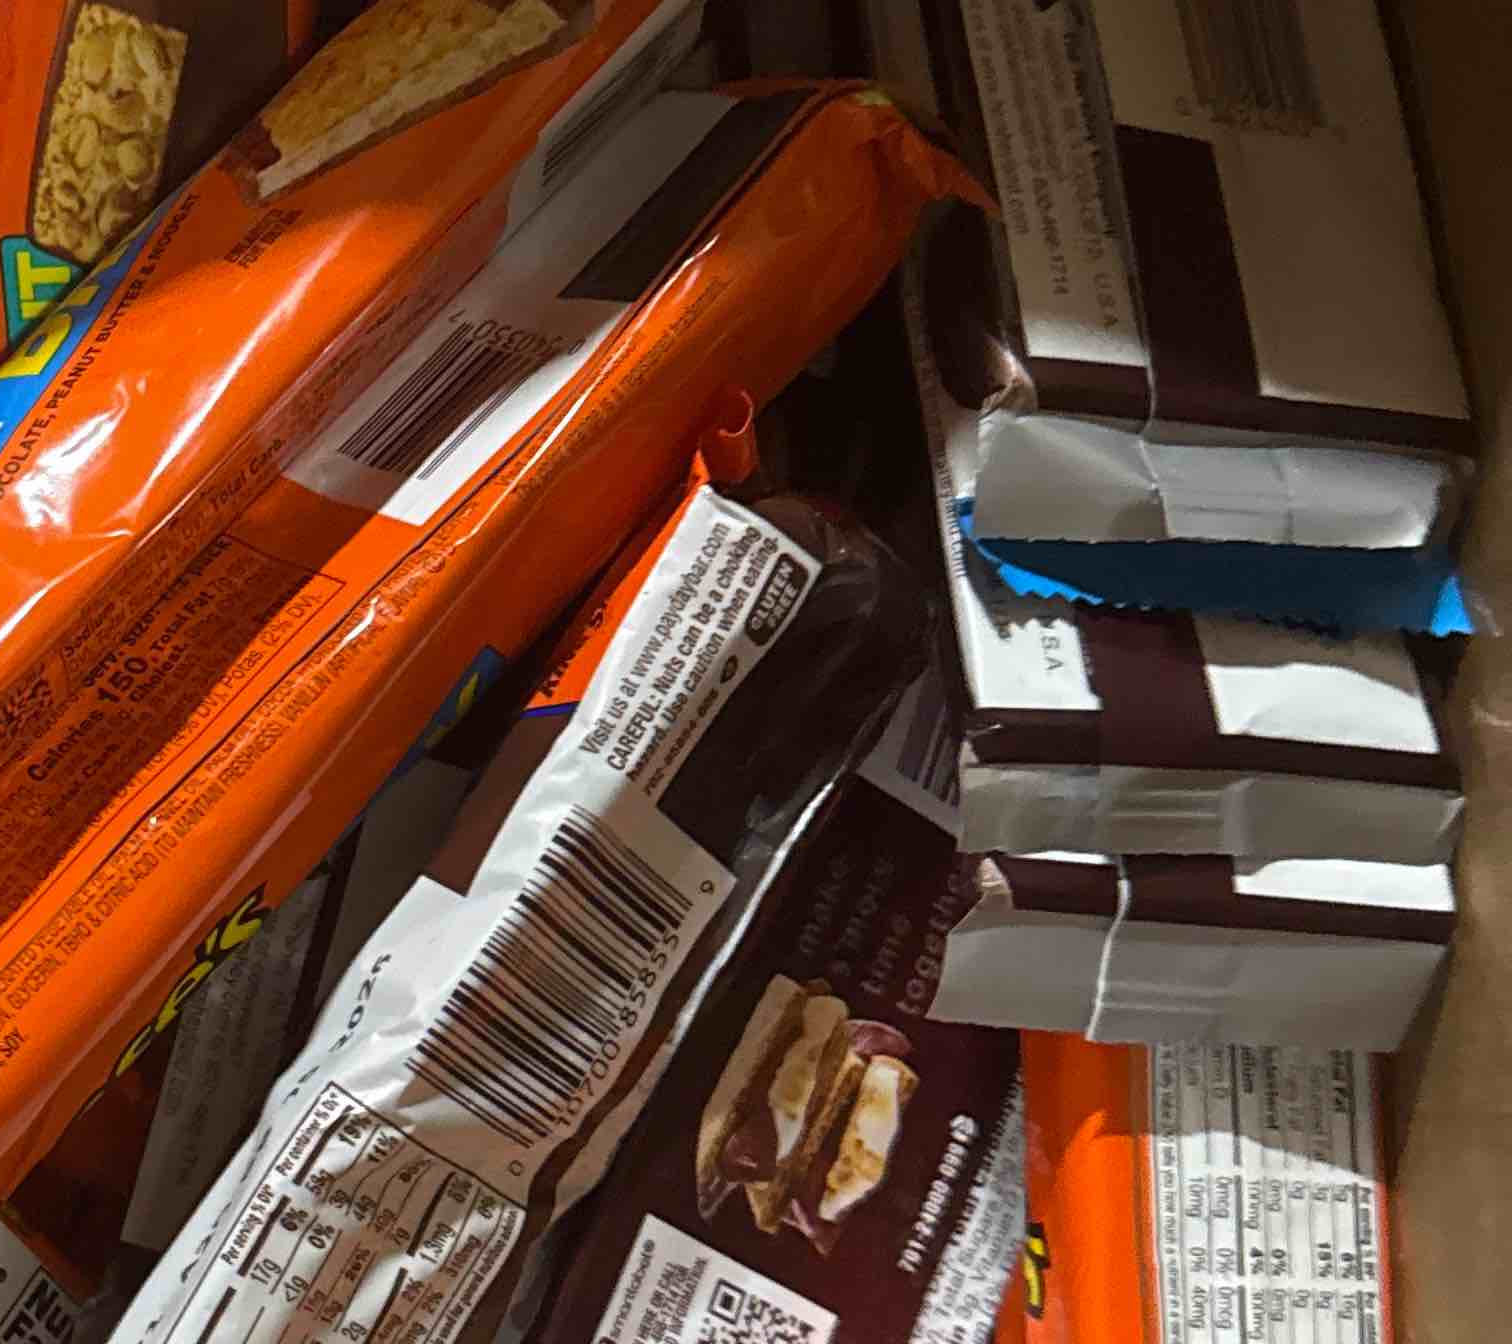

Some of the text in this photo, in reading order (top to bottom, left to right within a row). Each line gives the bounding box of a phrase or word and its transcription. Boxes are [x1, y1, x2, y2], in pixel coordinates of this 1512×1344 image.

[46, 341, 102, 415] PEANUT
[93, 273, 148, 347] BUTTER
[745, 560, 796, 633] GLUTEN
[764, 580, 801, 630] FREE
[579, 715, 616, 759] Visit
[626, 519, 734, 682] www.paydaybar.com
[604, 690, 664, 773] CAREFUL:
[650, 653, 686, 695] Nuts
[674, 623, 704, 658] can
[691, 599, 717, 626] be
[711, 522, 764, 591] choking
[678, 629, 726, 694] caution
[715, 586, 751, 633] when
[247, 1253, 281, 1288] 17g
[305, 1219, 337, 1252] 0%
[339, 1317, 366, 1343] 2g
